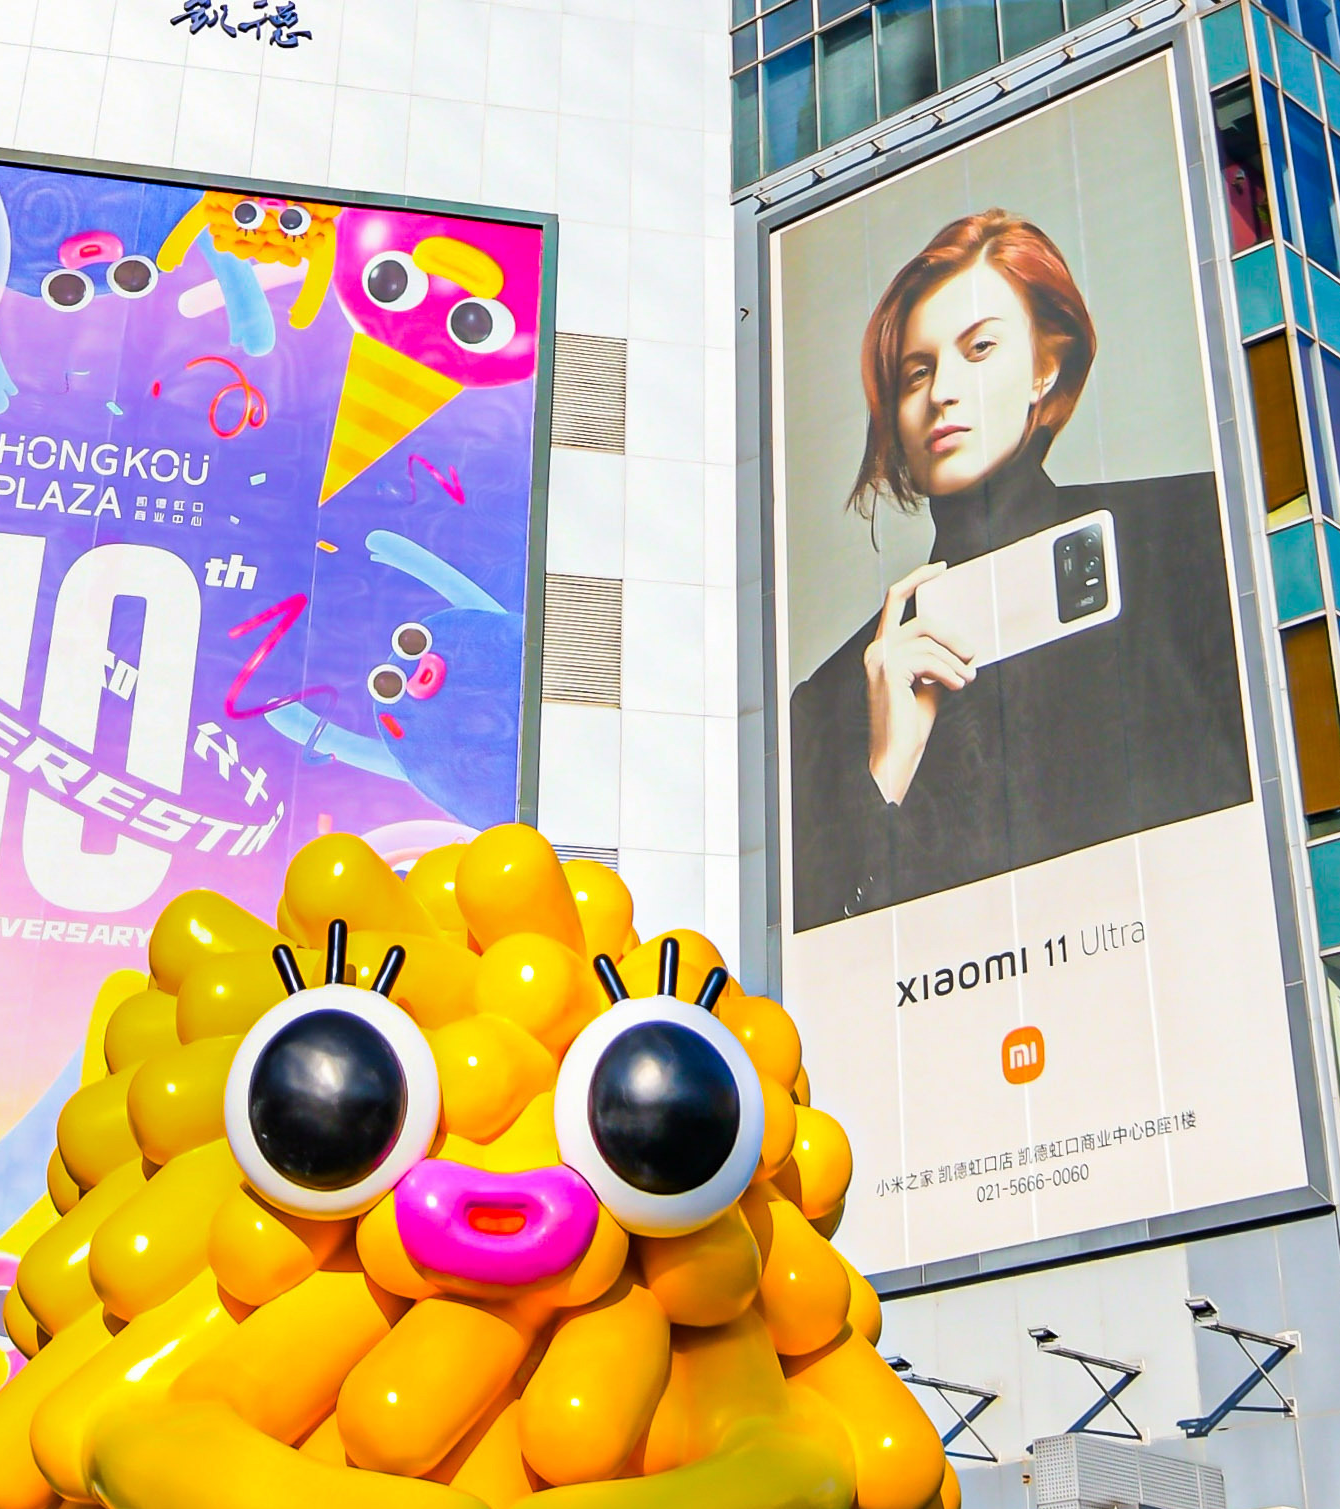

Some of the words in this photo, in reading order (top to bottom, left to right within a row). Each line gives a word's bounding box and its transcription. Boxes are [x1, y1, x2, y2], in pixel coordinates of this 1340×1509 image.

[1043, 935, 1069, 968] 11
[1079, 918, 1146, 957] Ultra
[875, 1168, 935, 1199] 小米之家
[938, 1150, 1014, 1185] 凯德虹口店
[976, 1162, 1090, 1203] 021-5666-0060
